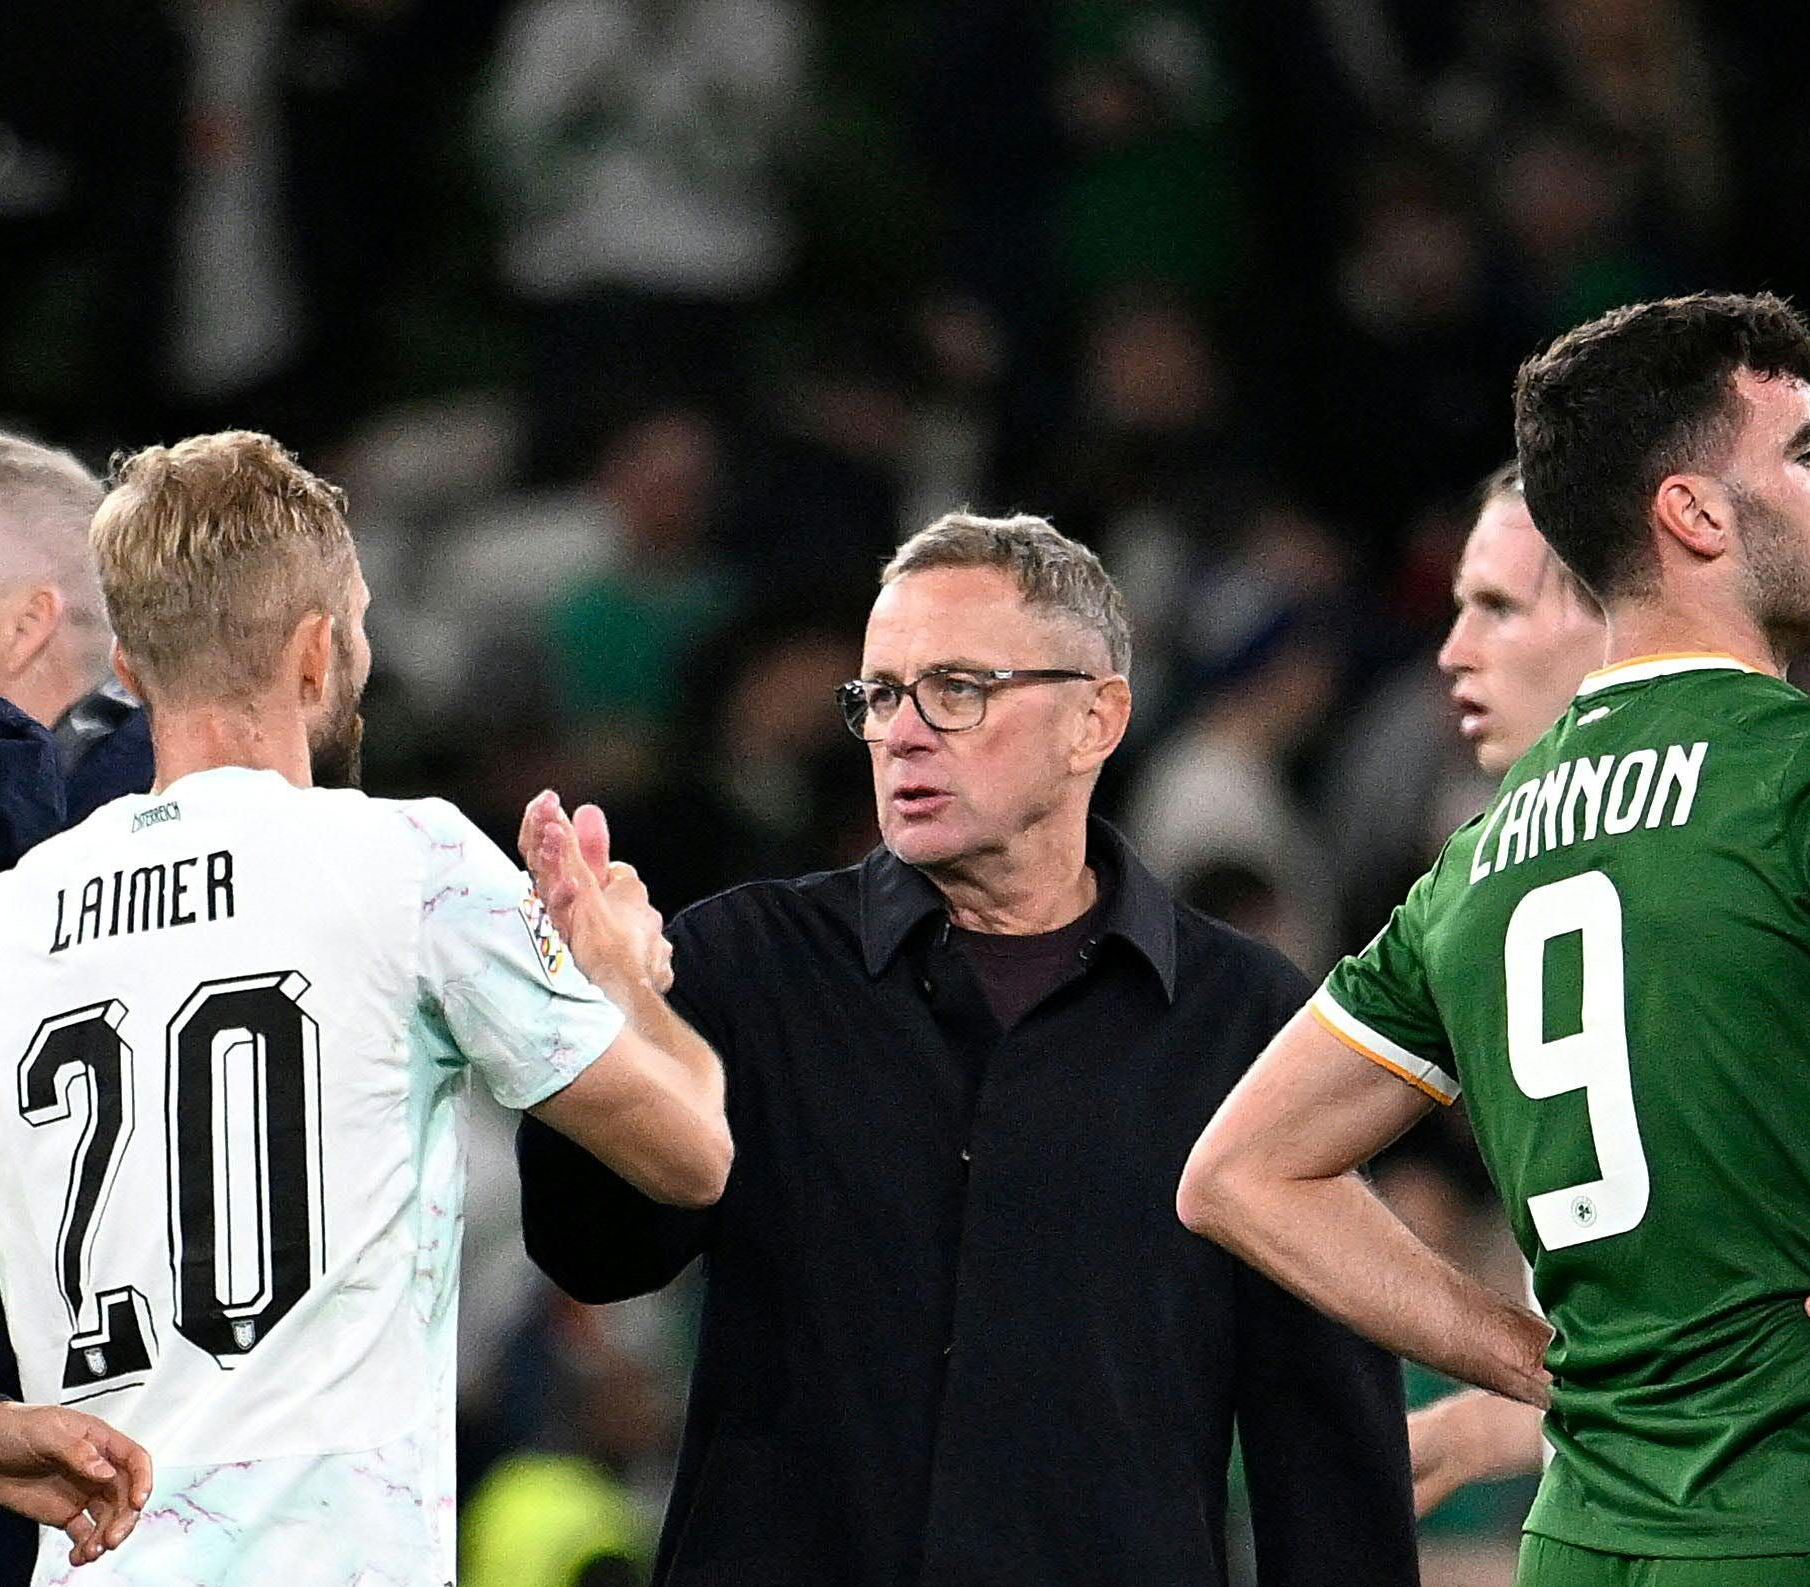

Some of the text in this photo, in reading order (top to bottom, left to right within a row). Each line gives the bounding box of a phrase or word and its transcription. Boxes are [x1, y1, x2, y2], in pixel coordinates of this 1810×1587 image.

[49, 849, 235, 955] LAIMER
[1504, 869, 1651, 1252] 9
[17, 969, 327, 1406] 20
